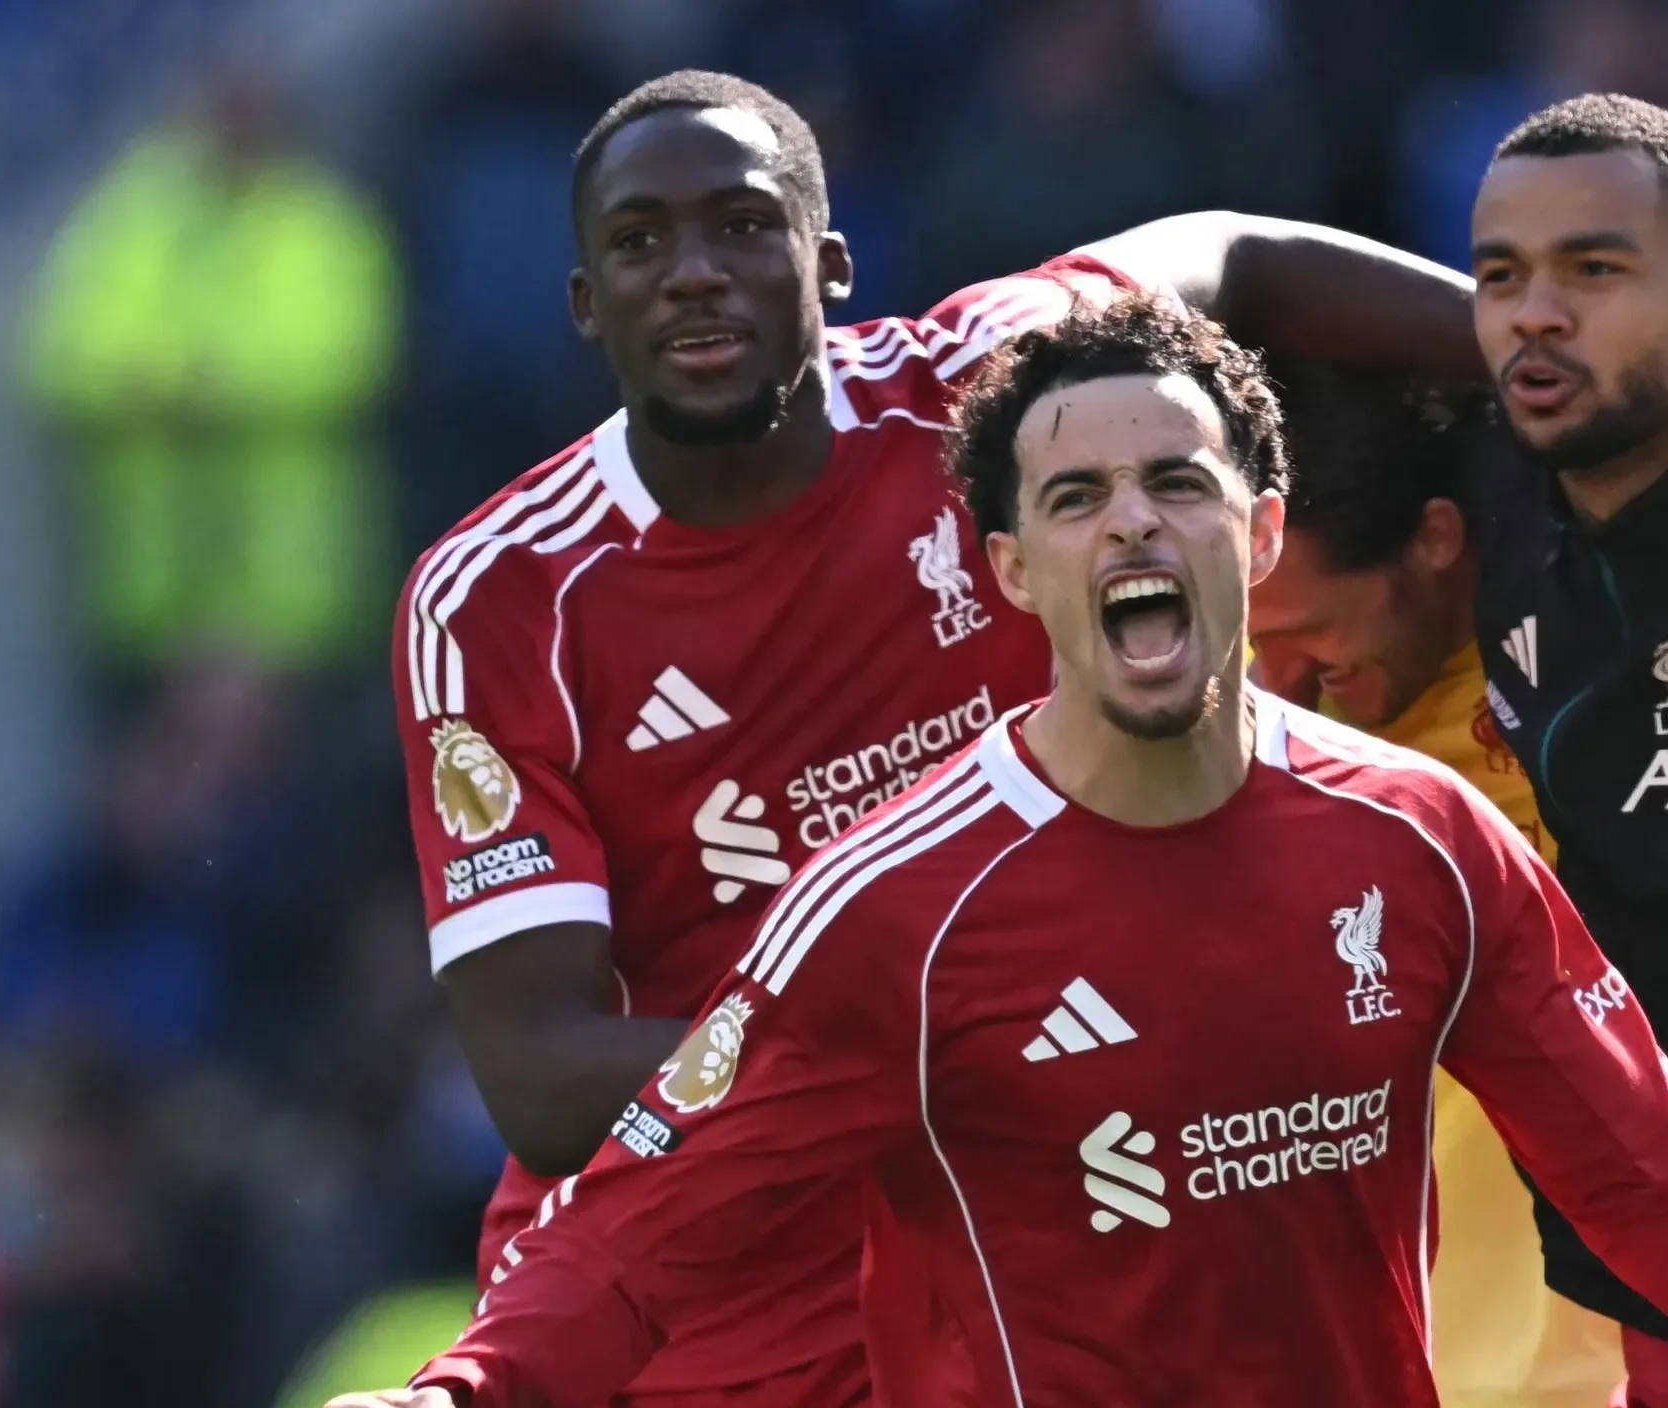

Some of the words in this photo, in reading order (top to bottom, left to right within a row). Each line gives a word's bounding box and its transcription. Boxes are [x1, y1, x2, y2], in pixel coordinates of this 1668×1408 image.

[786, 684, 994, 812] standard
[472, 837, 540, 872] room
[475, 854, 555, 890] racism
[1346, 992, 1402, 1025] L.F.C.
[1181, 1078, 1392, 1158] standard
[1187, 1115, 1390, 1200] chartered
